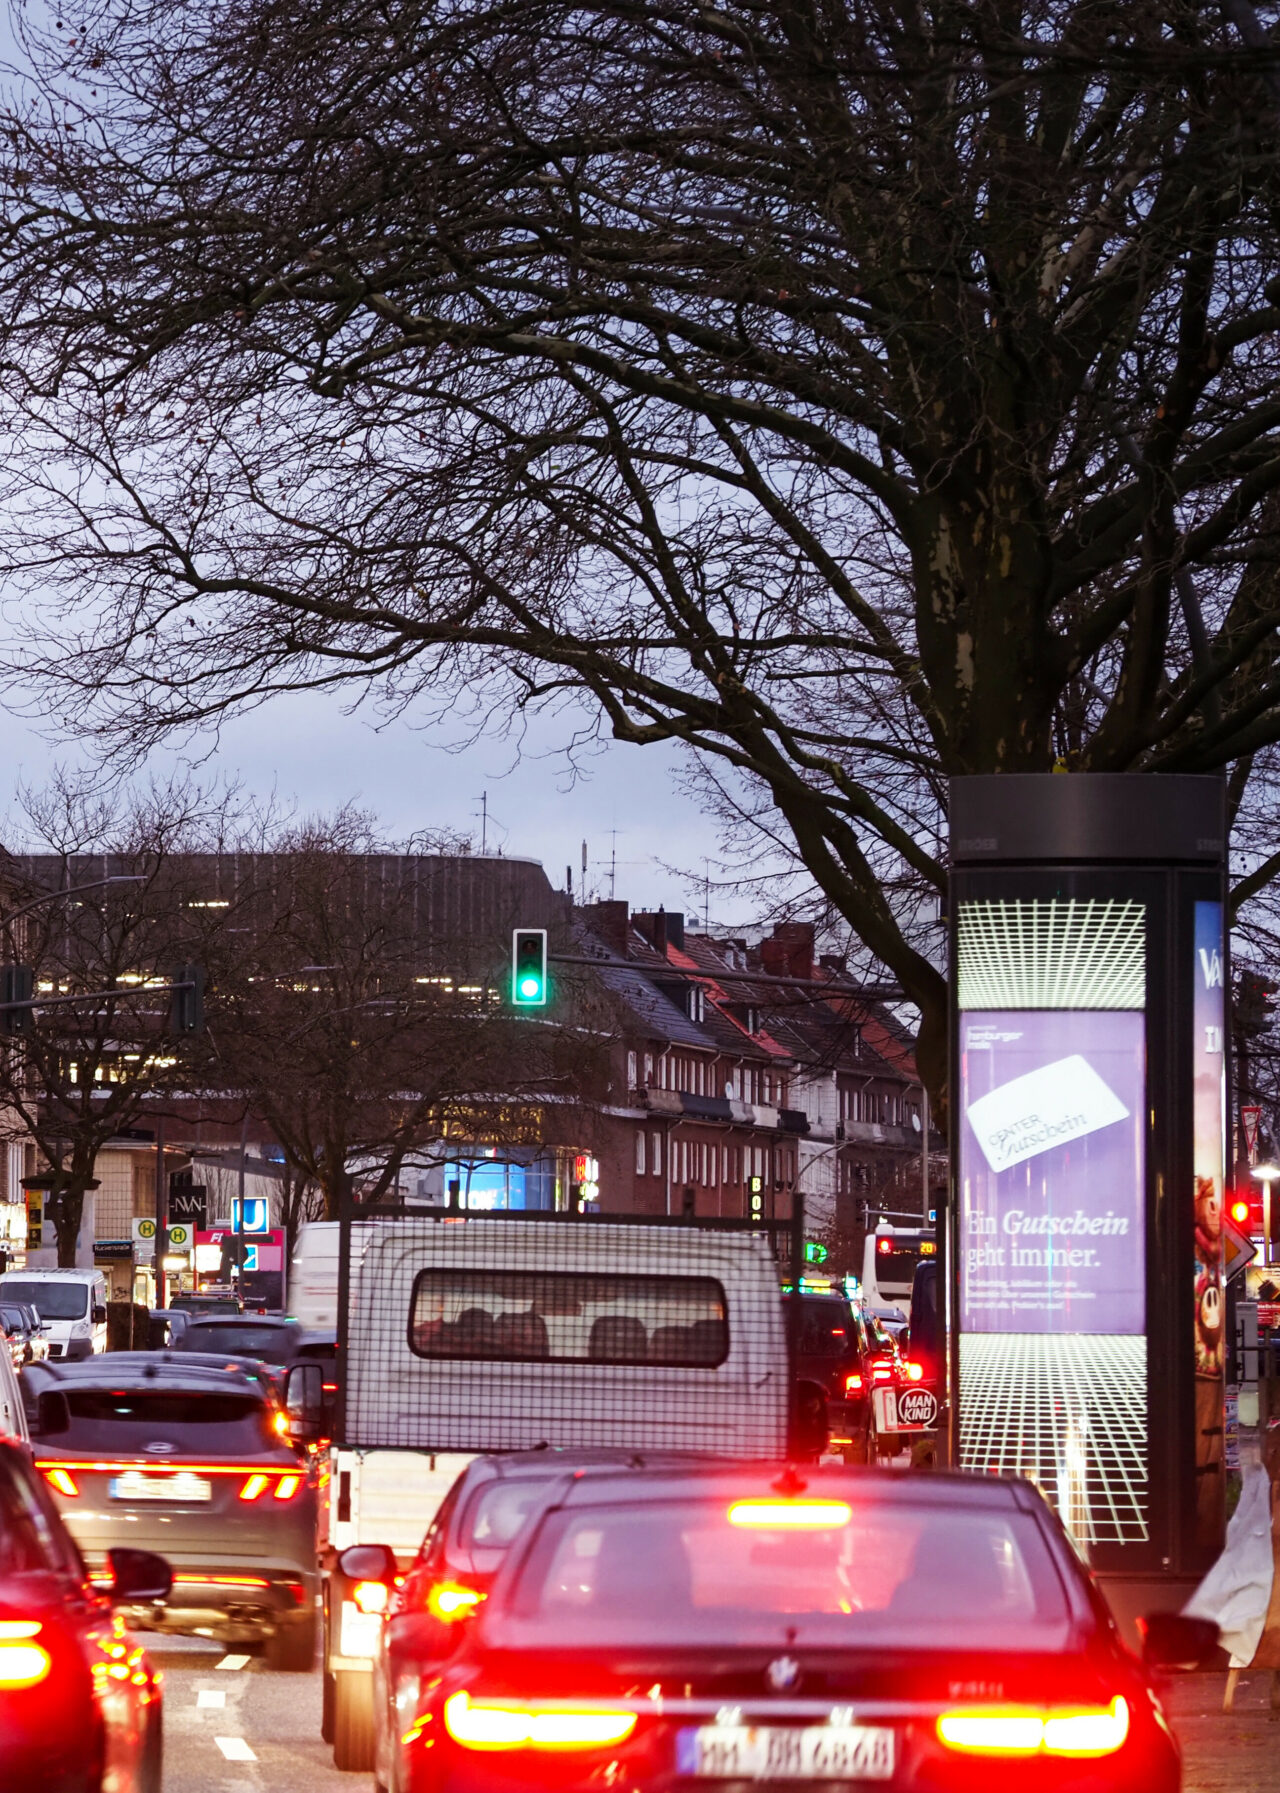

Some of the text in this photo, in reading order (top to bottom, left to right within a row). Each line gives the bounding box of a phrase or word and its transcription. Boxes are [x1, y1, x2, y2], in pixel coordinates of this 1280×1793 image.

[988, 1114, 1041, 1146] CENTER
[236, 1200, 264, 1231] U
[967, 1210, 1129, 1235] Ein Gutschein
[967, 1241, 1101, 1273] geht immer.
[904, 1407, 932, 1421] KIND
[905, 1395, 932, 1408] MAN
